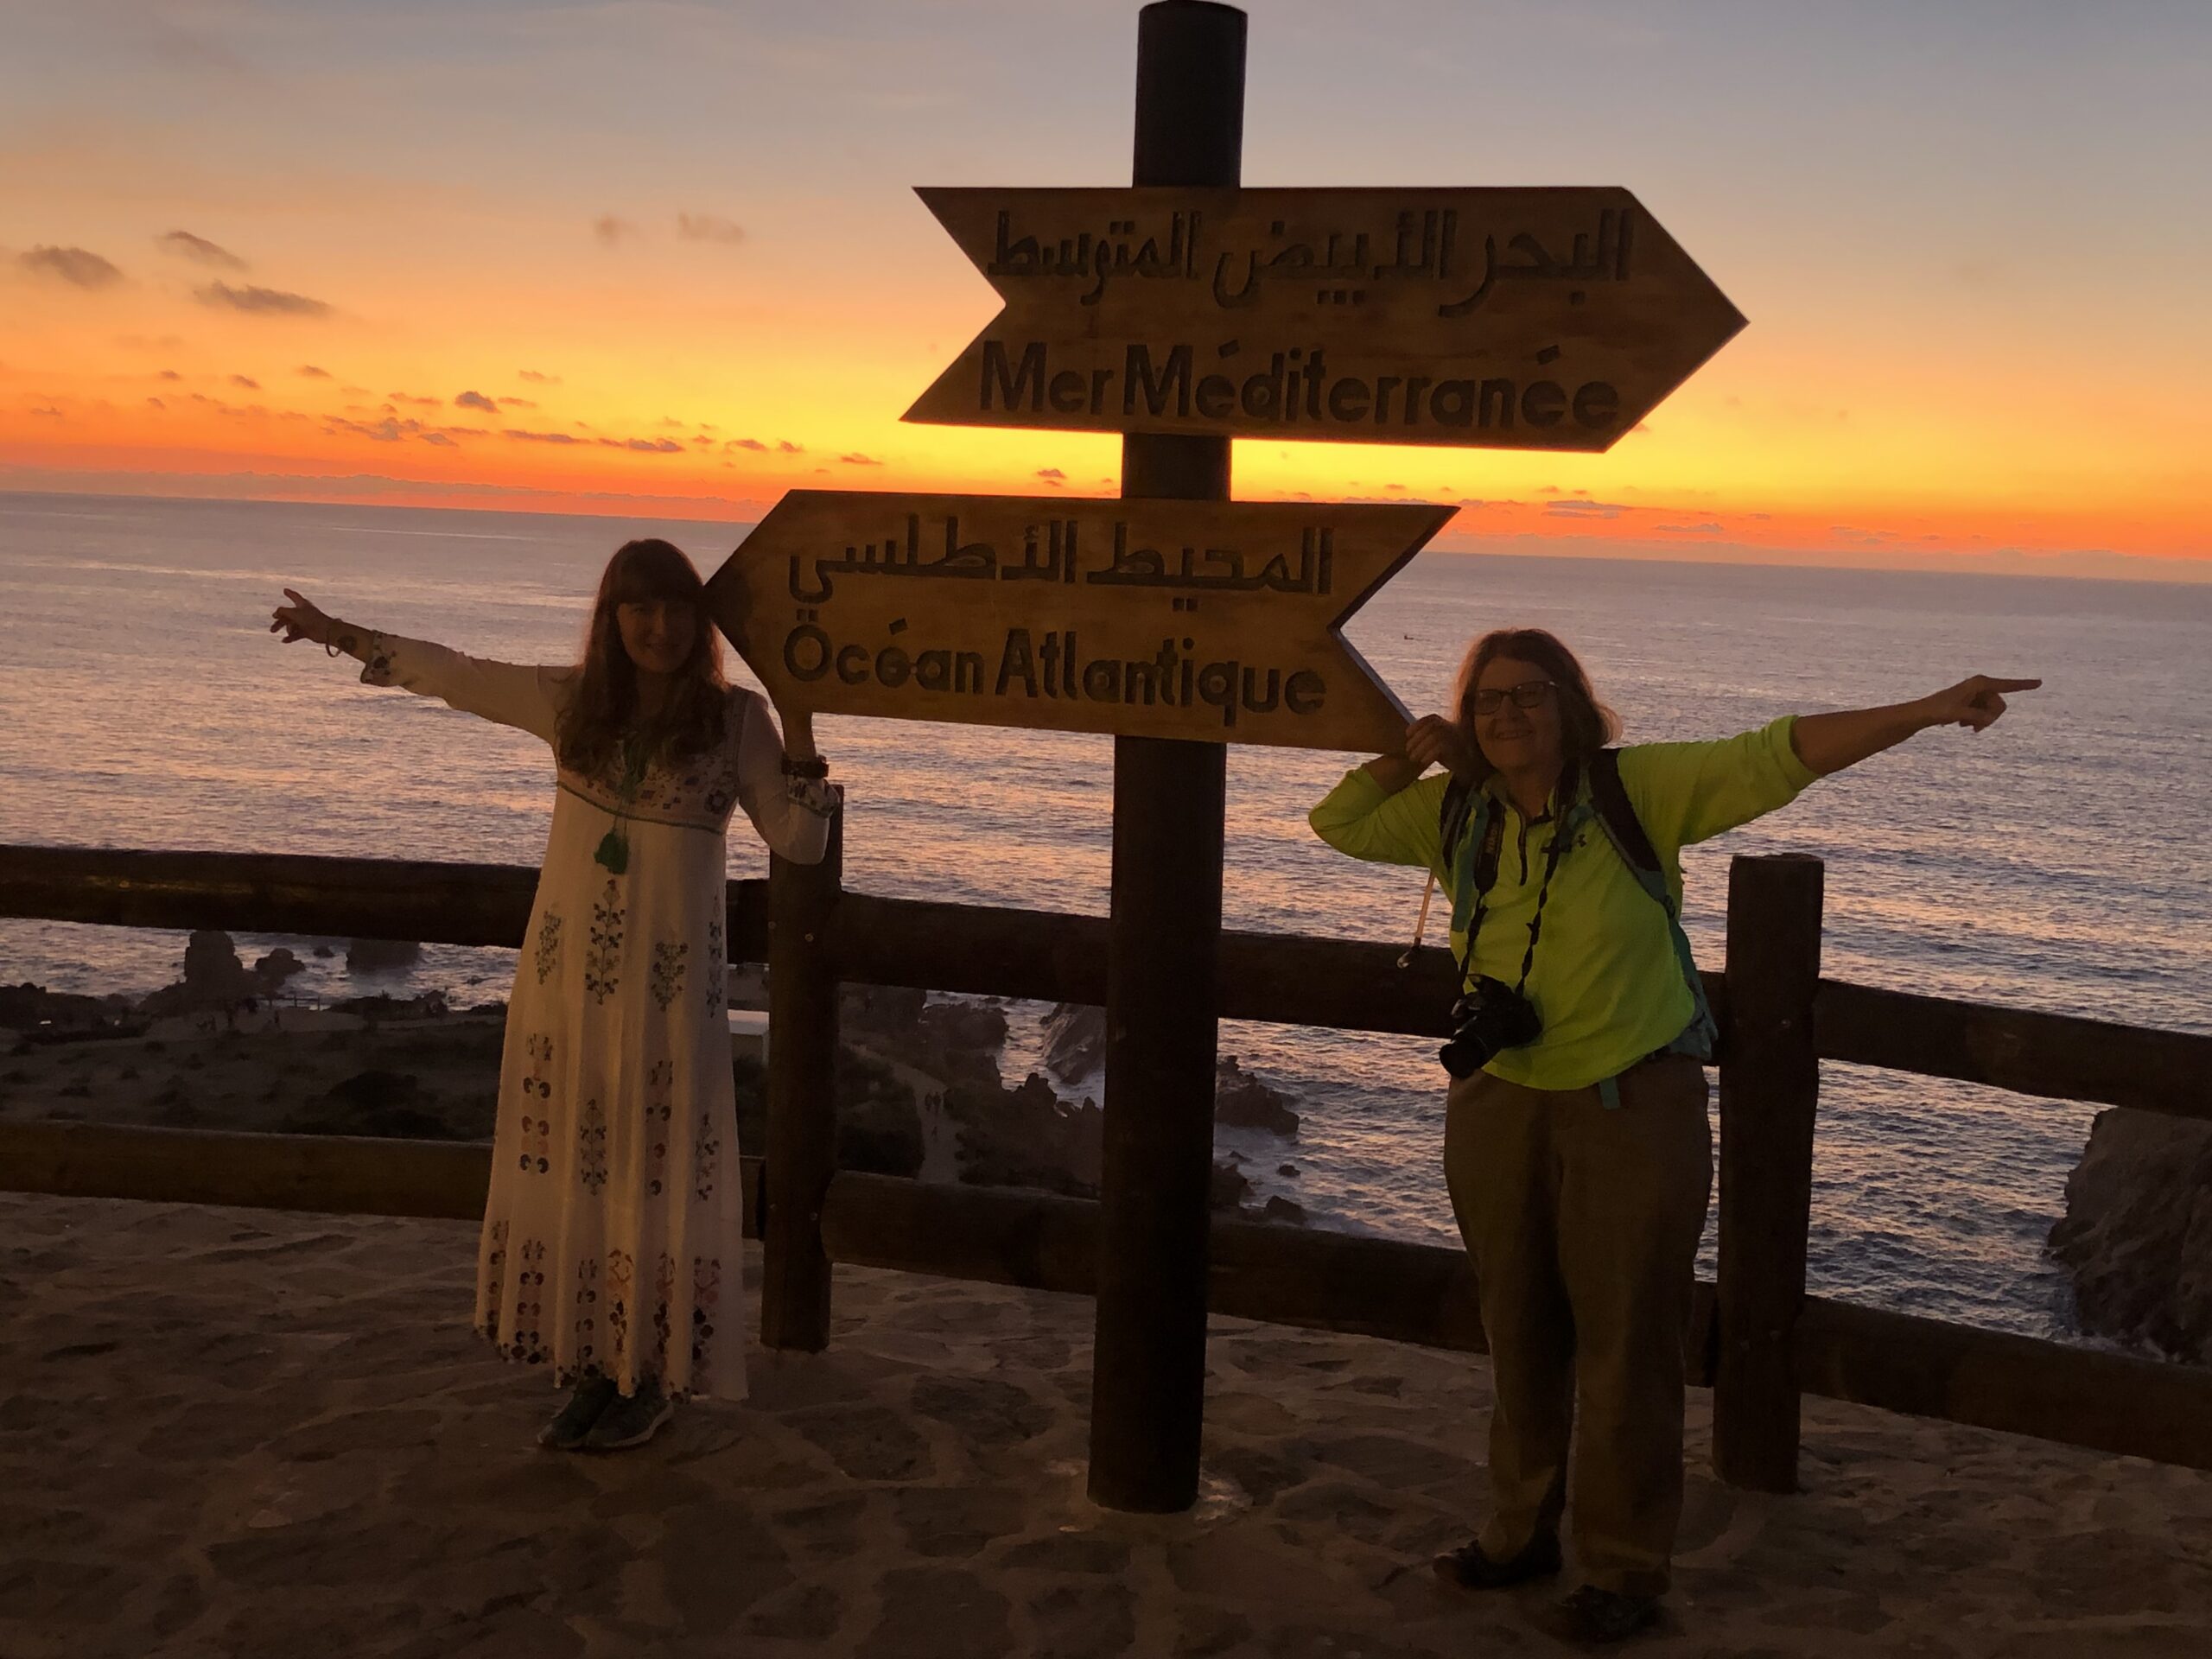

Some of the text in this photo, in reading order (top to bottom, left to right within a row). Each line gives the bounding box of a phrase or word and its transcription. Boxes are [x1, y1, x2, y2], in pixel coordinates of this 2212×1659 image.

[987, 209, 1203, 307] المتوسط
[1438, 207, 1635, 318] البحر
[979, 339, 1620, 429] Mer Méditerranée
[1086, 520, 1335, 612] المحيط
[783, 617, 1329, 728] Océan Atlantique
